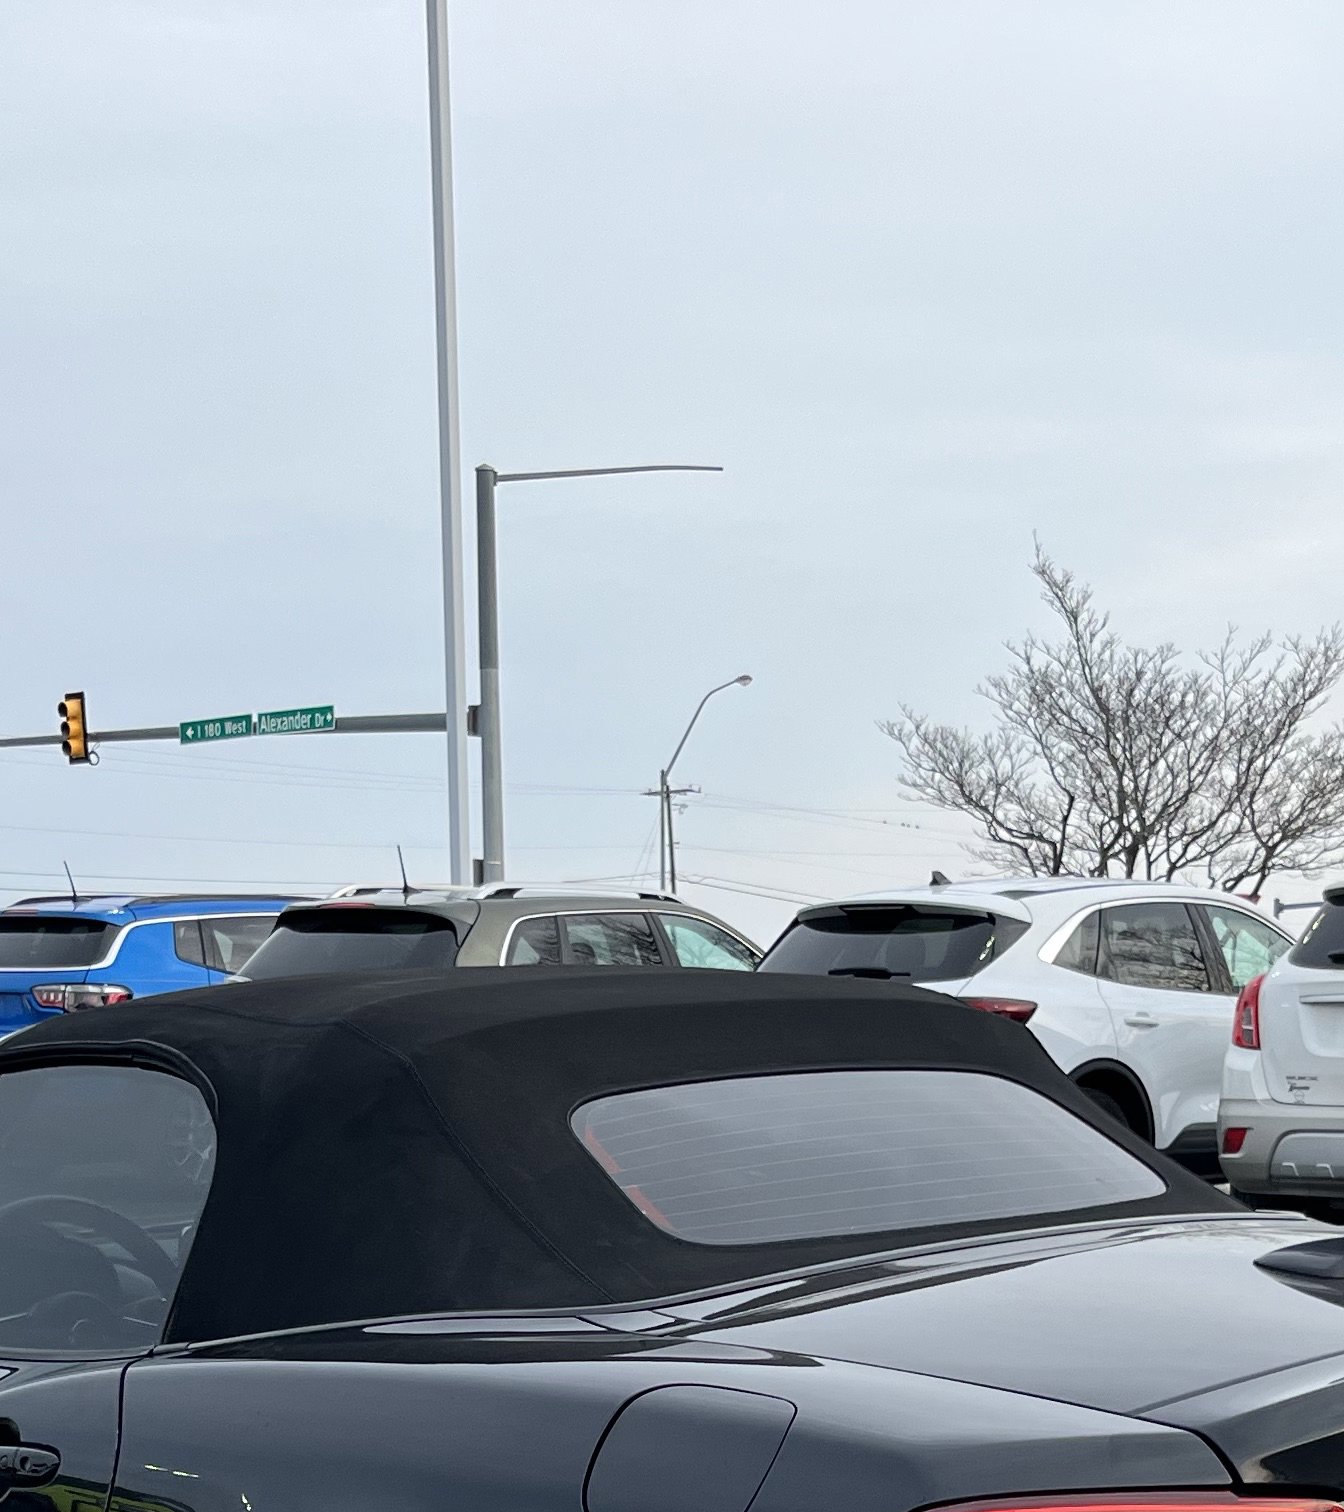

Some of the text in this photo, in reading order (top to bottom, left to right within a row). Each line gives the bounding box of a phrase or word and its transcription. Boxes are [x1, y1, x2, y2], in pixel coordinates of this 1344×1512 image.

[204, 722, 221, 738] 180
[224, 720, 246, 735] West
[259, 711, 325, 733] Alexander Dr
